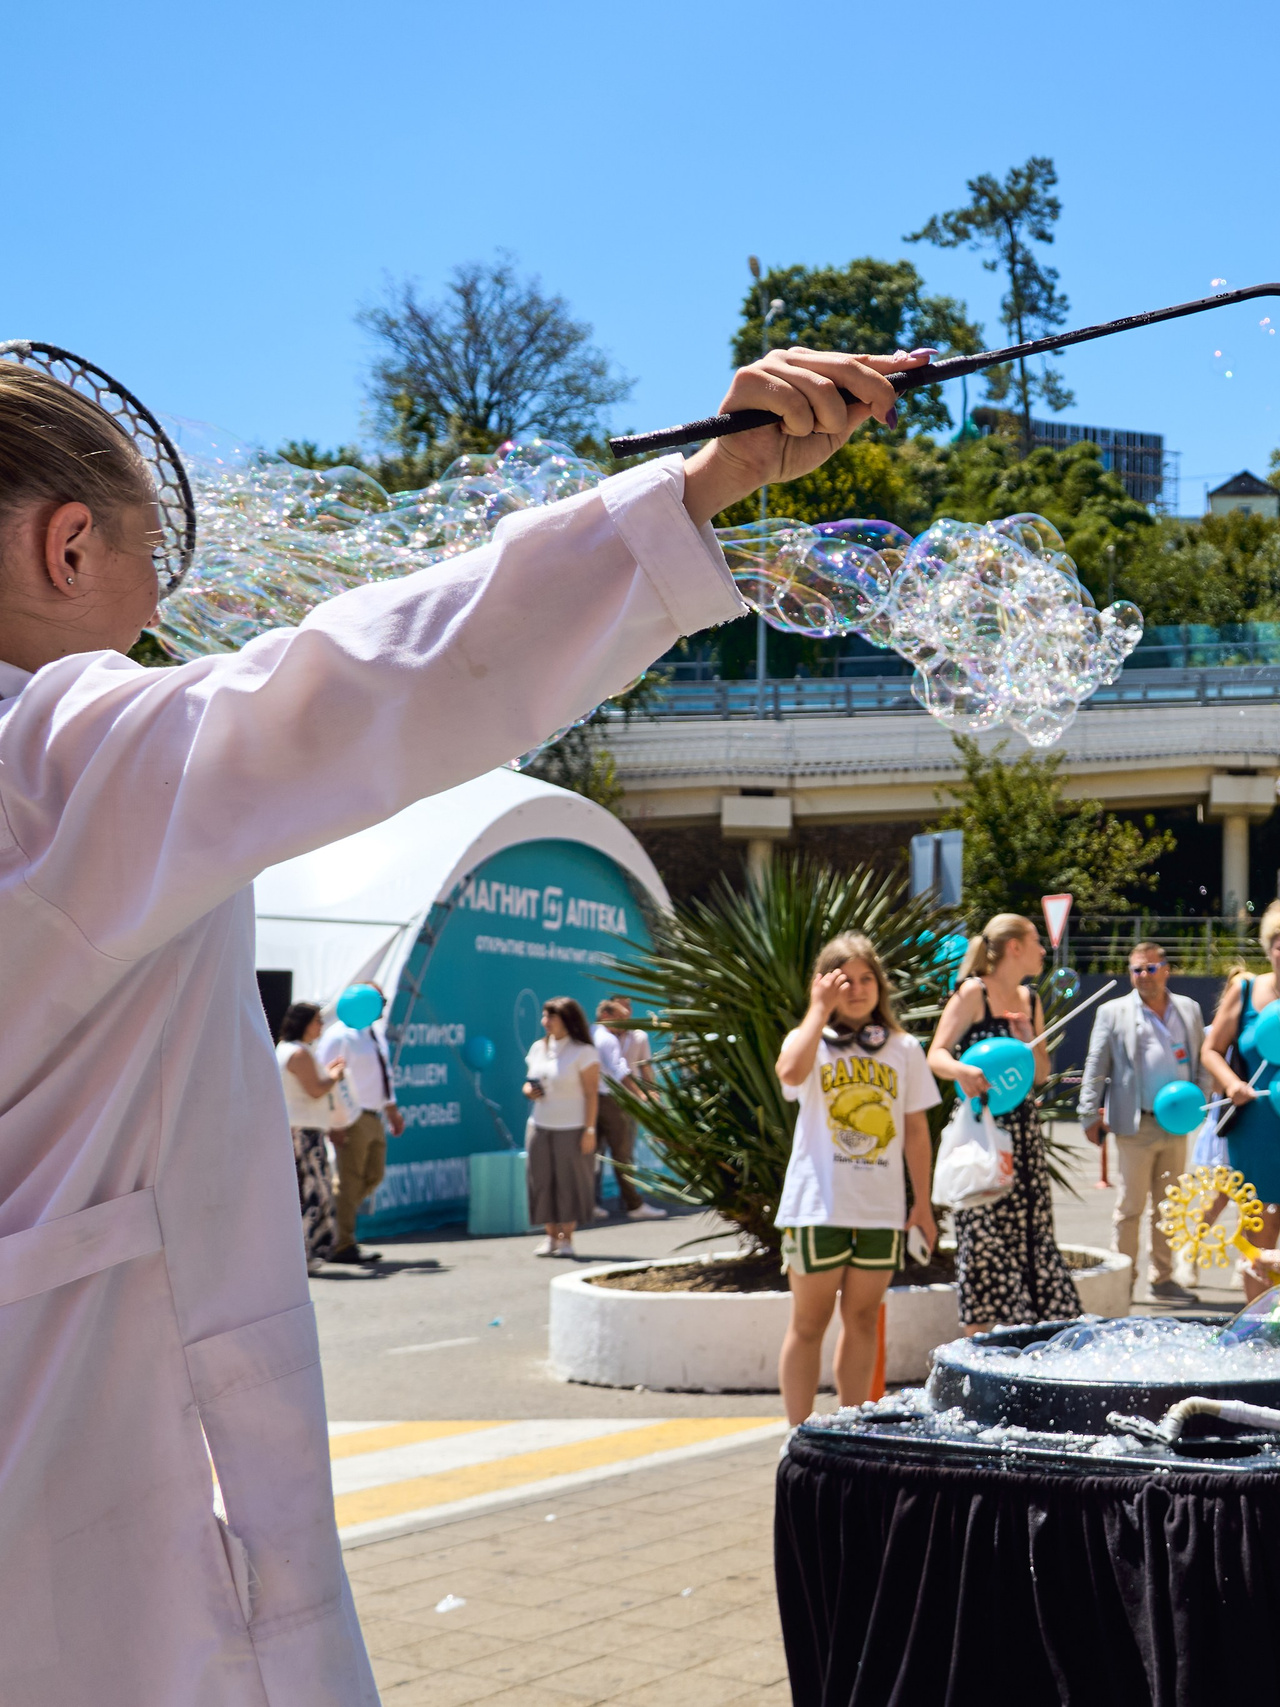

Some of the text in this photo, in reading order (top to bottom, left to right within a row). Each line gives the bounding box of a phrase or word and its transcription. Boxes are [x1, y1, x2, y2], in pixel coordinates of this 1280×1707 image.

[458, 880, 628, 935] МАГНИТ АПТЕКА
[821, 1056, 898, 1099] GANNI
